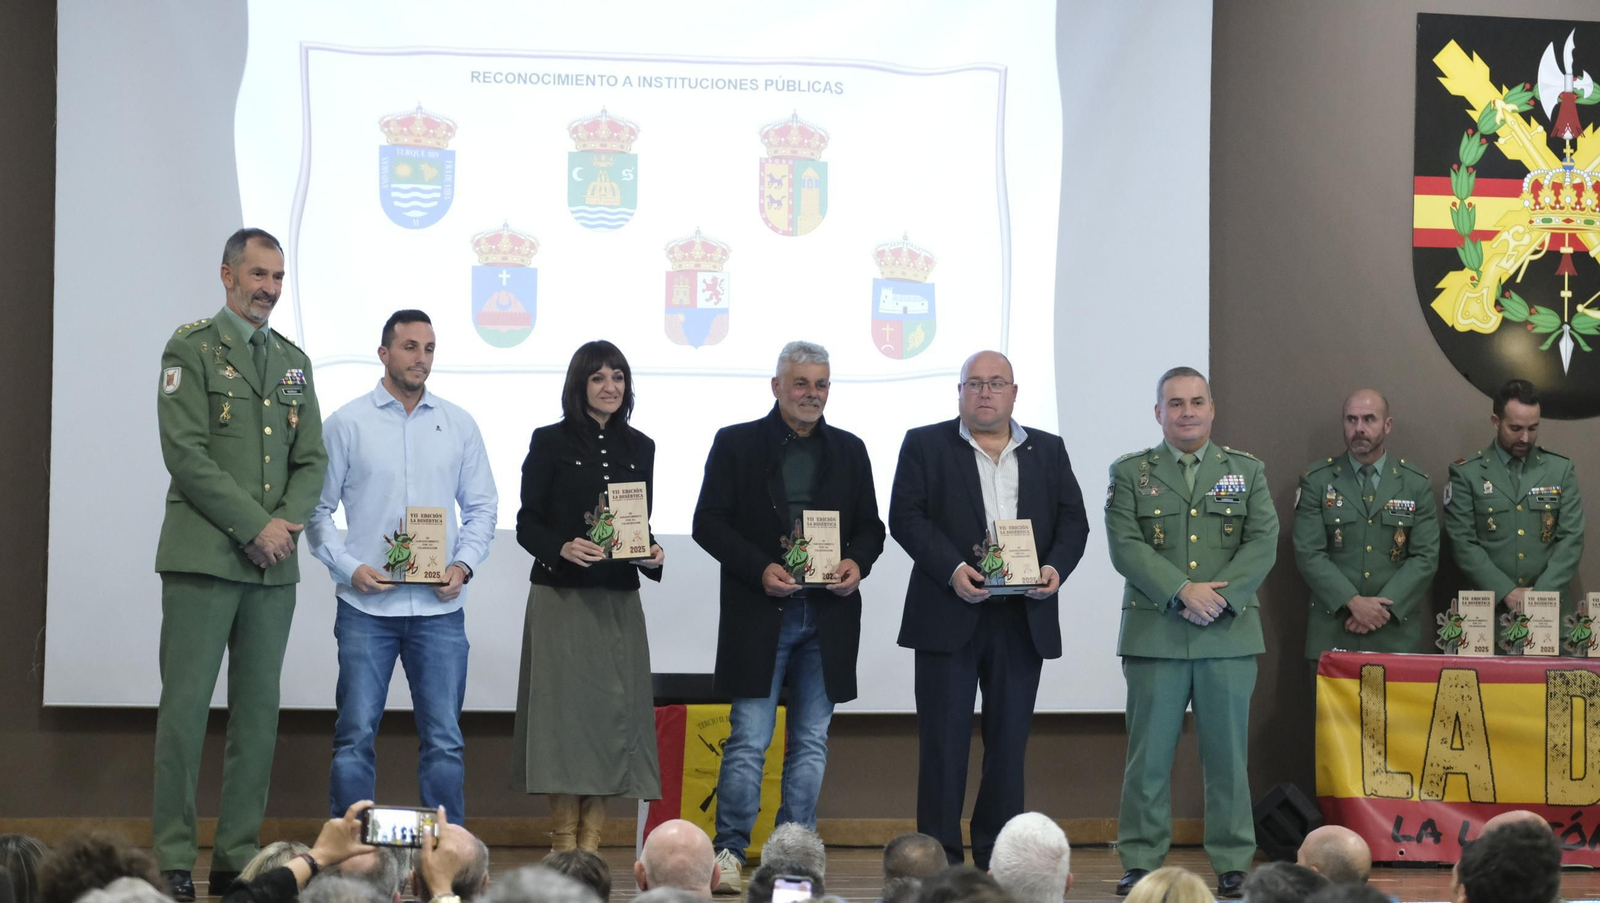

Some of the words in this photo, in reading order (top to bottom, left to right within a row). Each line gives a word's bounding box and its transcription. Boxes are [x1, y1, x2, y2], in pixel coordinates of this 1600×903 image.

[470, 70, 618, 87] RECONOCIMIENTO
[622, 75, 633, 88] A
[637, 75, 760, 91] INSTITUCIONES
[764, 75, 844, 95] PÚBLICAS
[630, 545, 646, 554] 2025
[424, 571, 441, 579] 2025
[822, 572, 837, 581] 202
[1474, 645, 1490, 653] 2025
[697, 716, 719, 730] TERCIO
[1358, 662, 1497, 804] LA
[1391, 814, 1444, 845] LA
